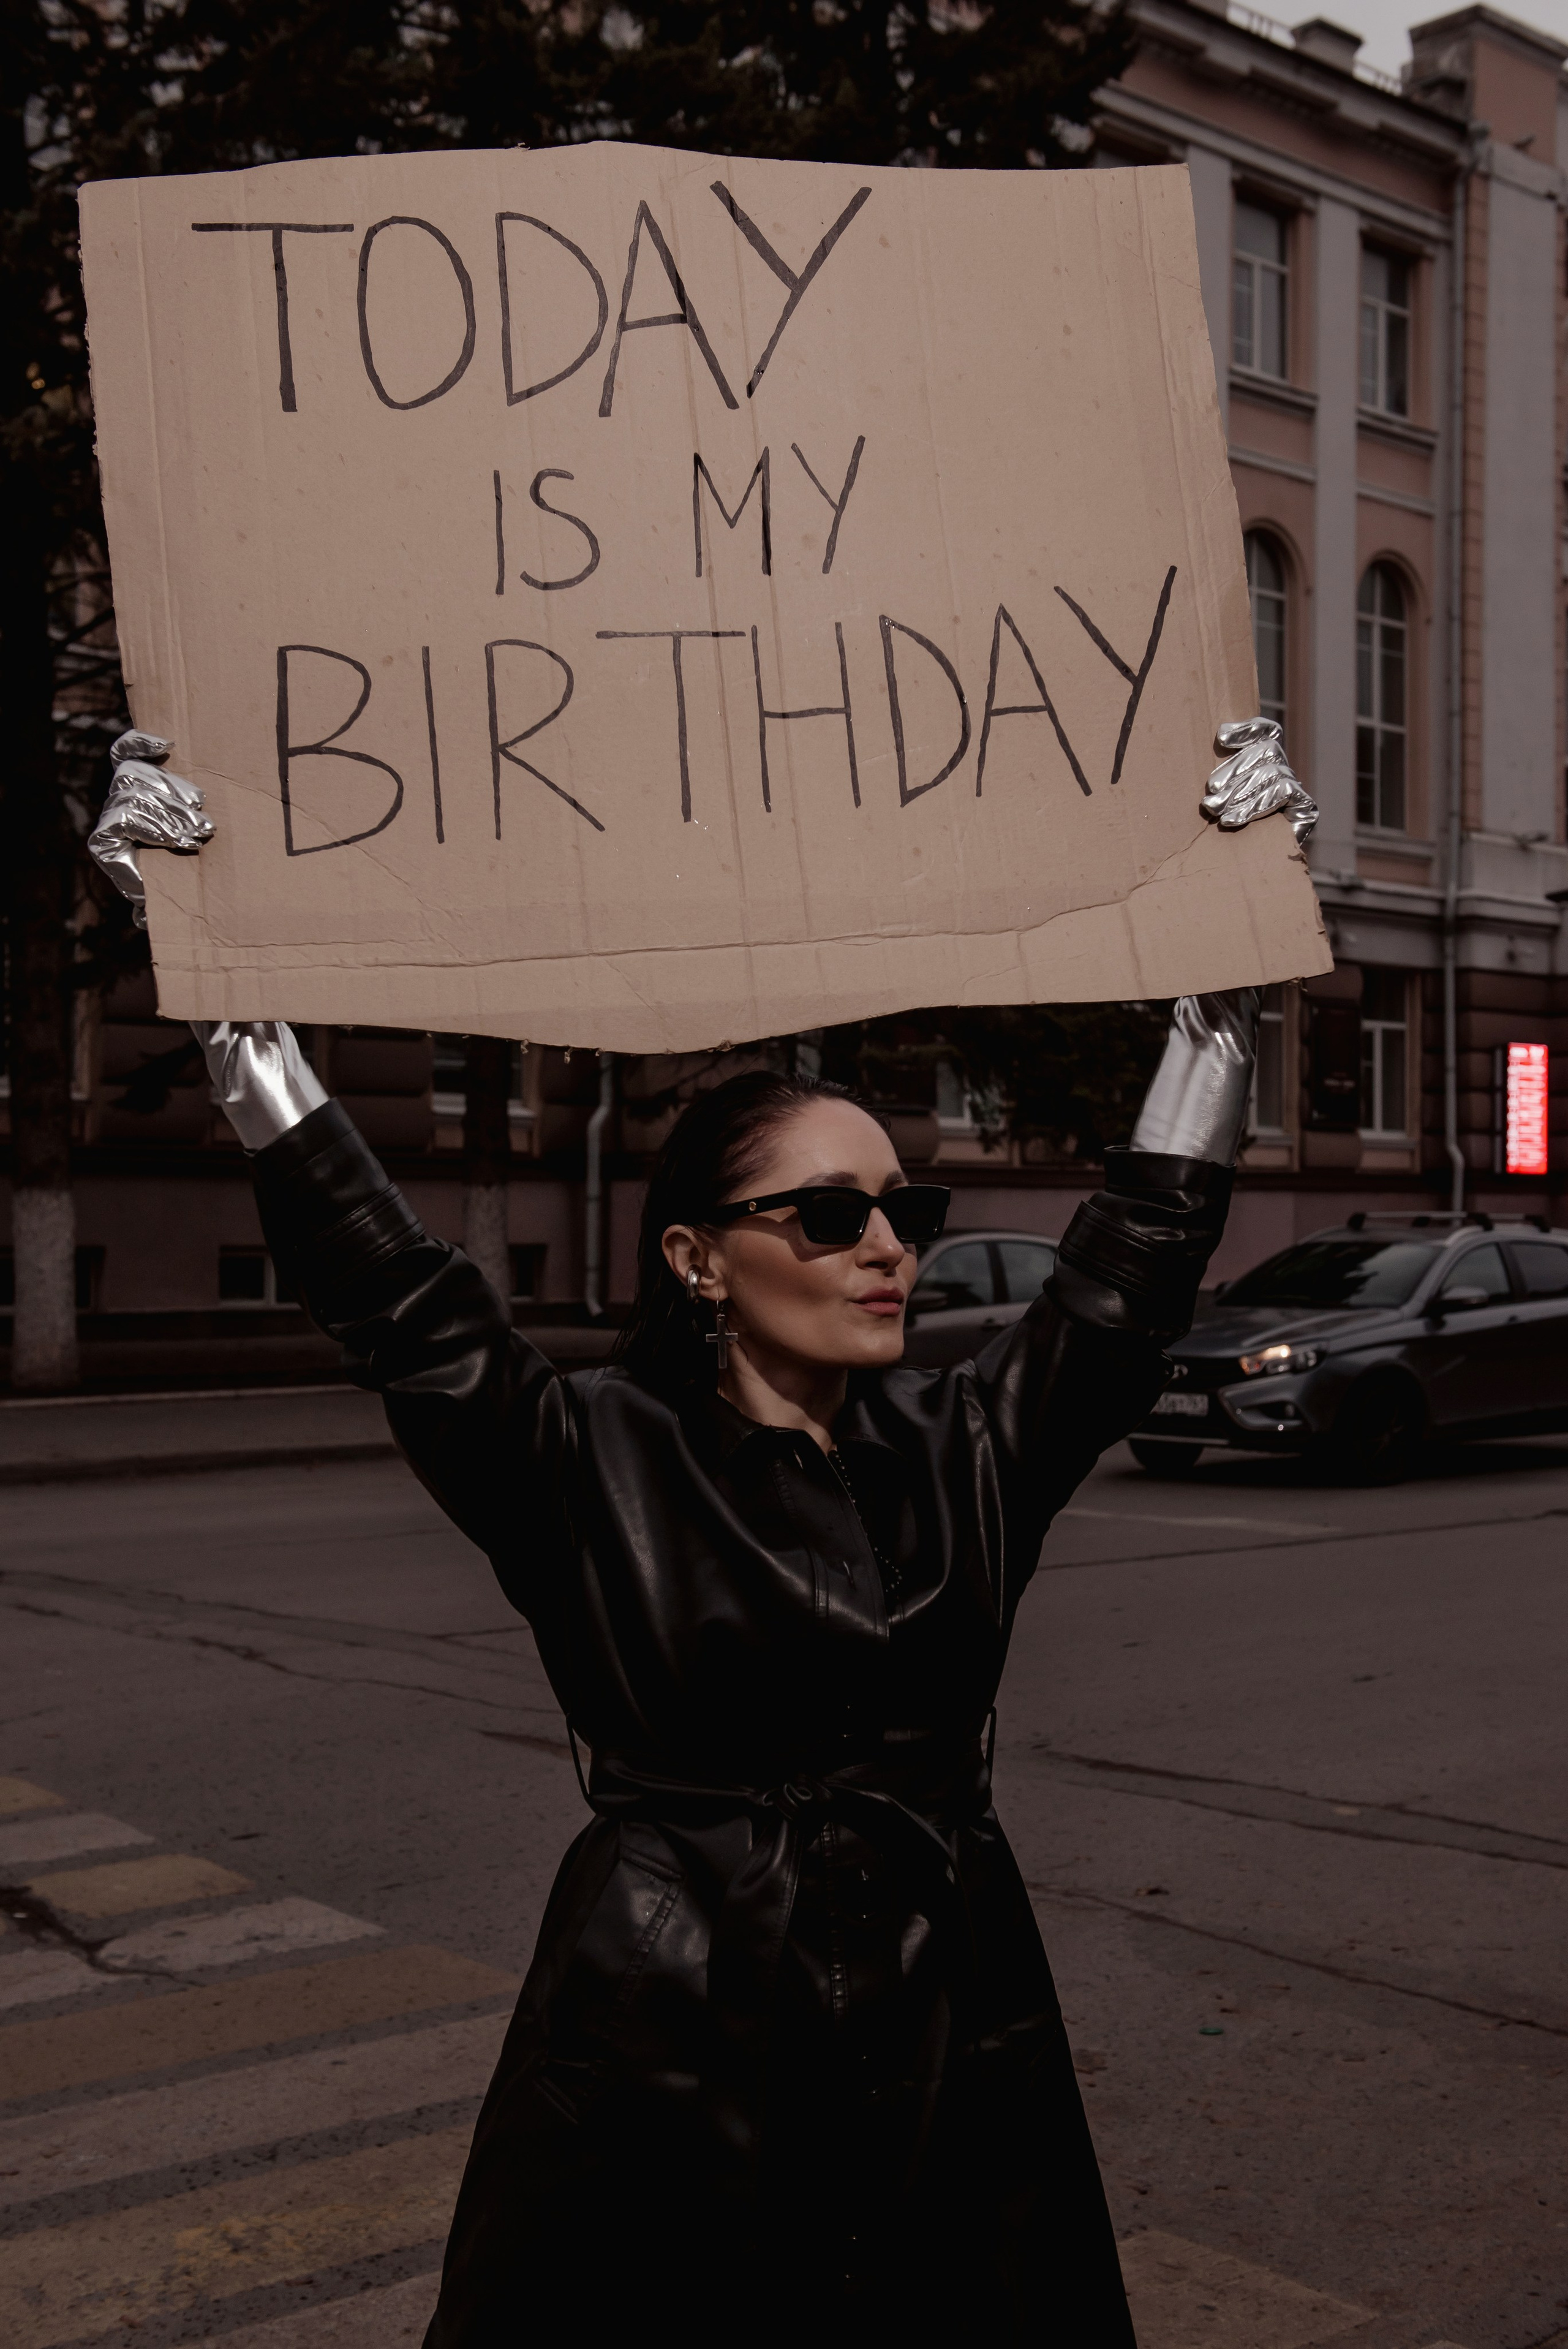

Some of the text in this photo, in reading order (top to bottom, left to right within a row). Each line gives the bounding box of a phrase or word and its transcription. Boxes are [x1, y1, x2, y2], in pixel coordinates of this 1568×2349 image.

[191, 181, 873, 418] TODAY
[493, 435, 866, 596] IS MY
[277, 565, 1178, 858] BIRTHDAY
